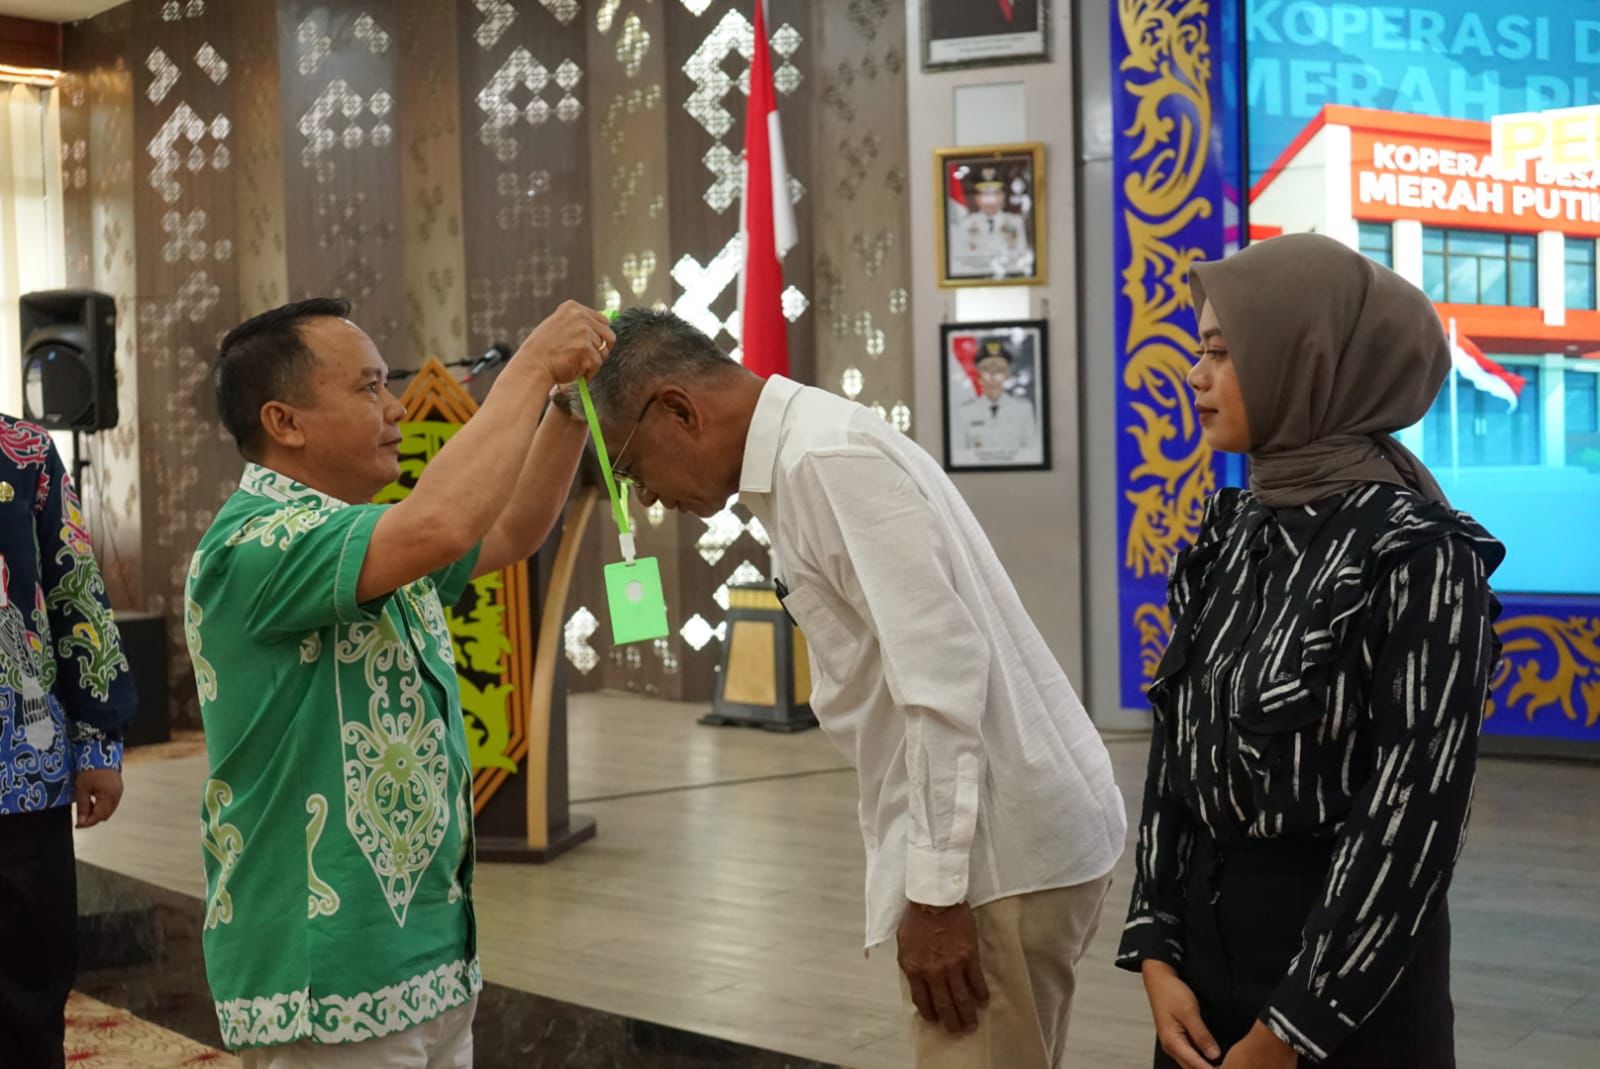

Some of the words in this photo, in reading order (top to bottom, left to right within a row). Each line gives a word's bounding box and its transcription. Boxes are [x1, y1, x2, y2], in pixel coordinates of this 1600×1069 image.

[1247, 0, 1550, 60] KOPERASI
[1248, 57, 1499, 123] MERAH
[1501, 112, 1600, 170] PE
[1359, 171, 1504, 215] MERAH
